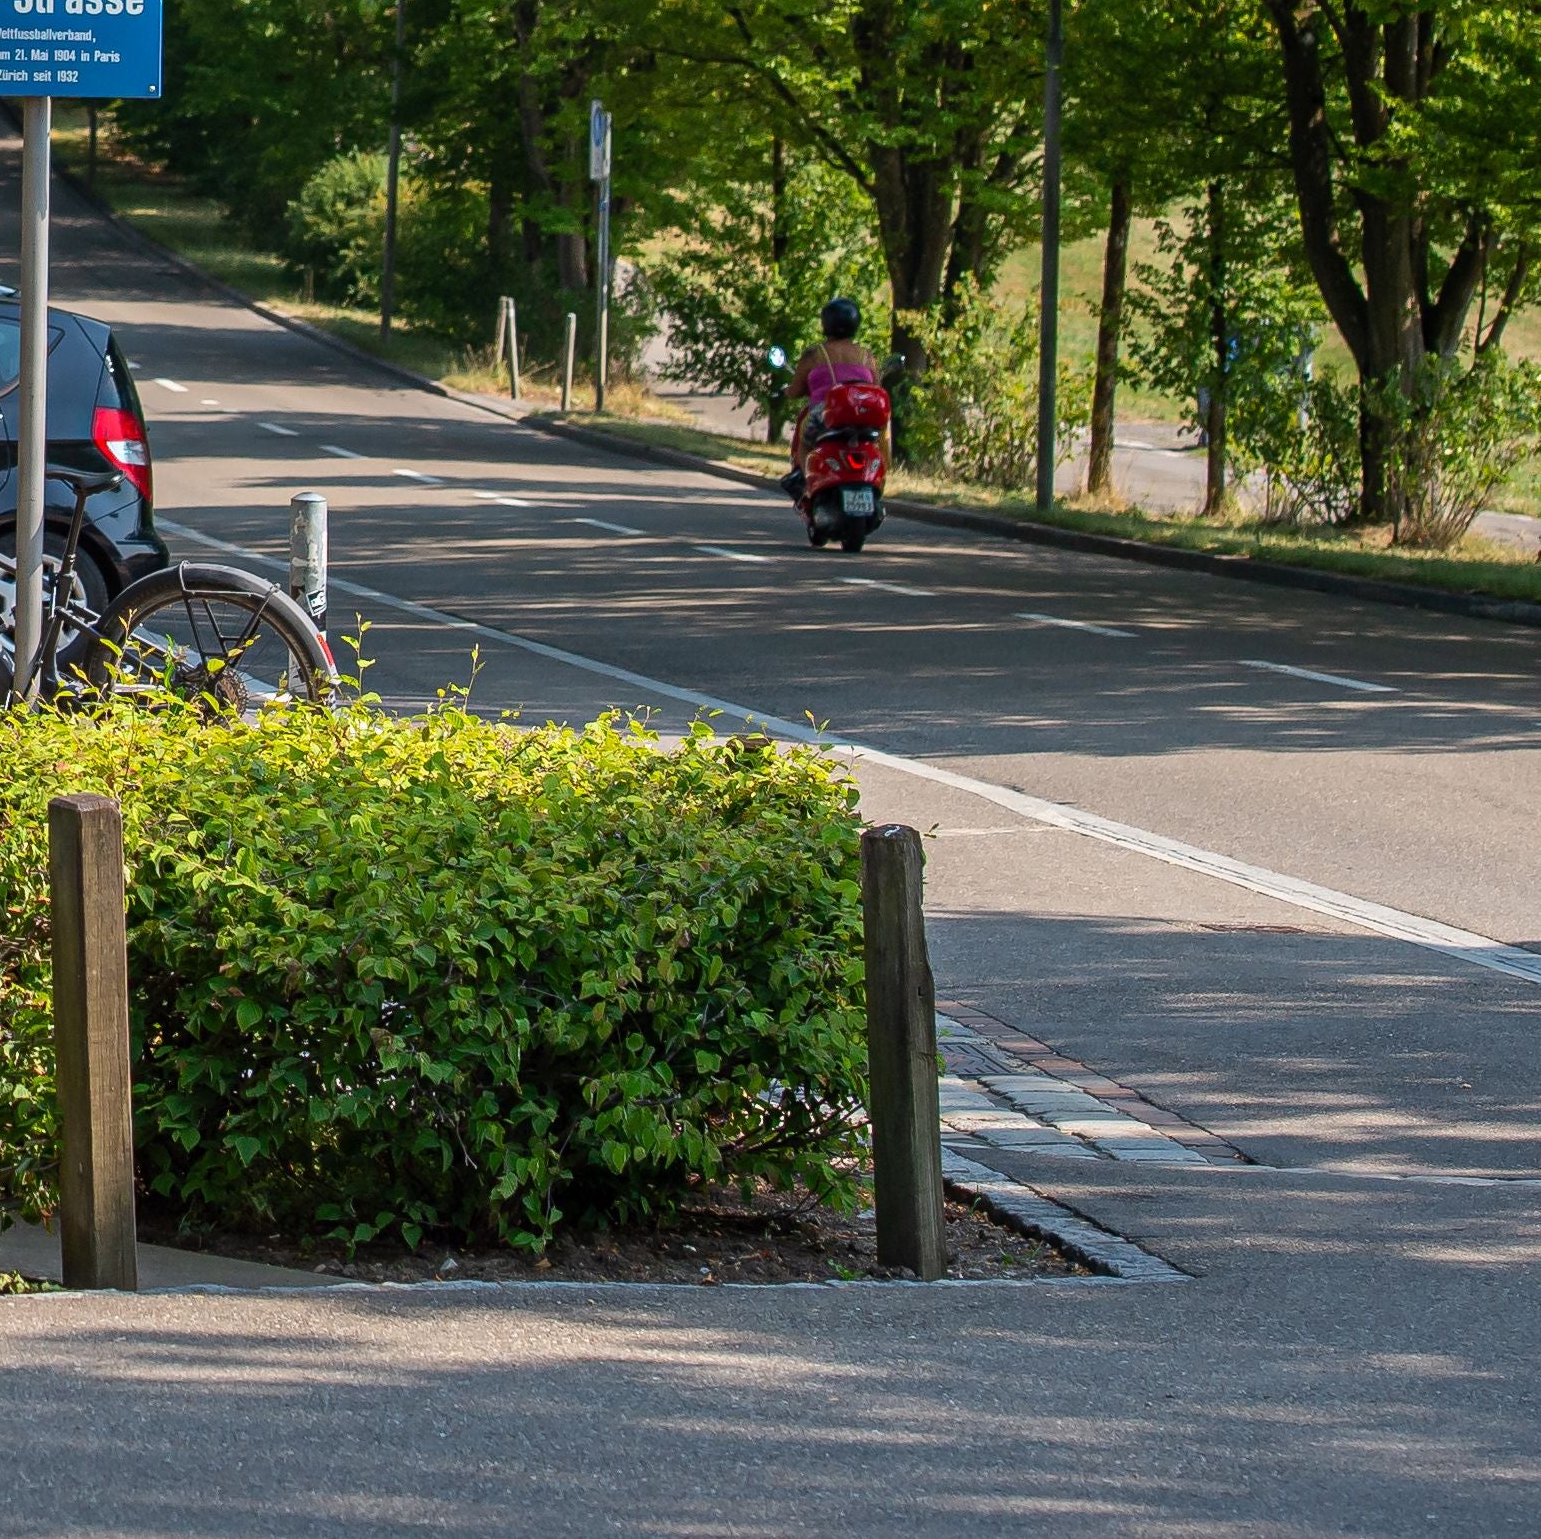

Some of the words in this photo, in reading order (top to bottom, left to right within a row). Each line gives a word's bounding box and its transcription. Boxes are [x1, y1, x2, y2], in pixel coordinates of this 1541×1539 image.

[14, 49, 28, 62] 21.
[31, 49, 49, 62] Mai
[54, 50, 76, 62] 1904
[80, 50, 90, 62] in
[94, 51, 121, 63] Paris
[33, 70, 52, 83] seit
[57, 70, 79, 83] 1932
